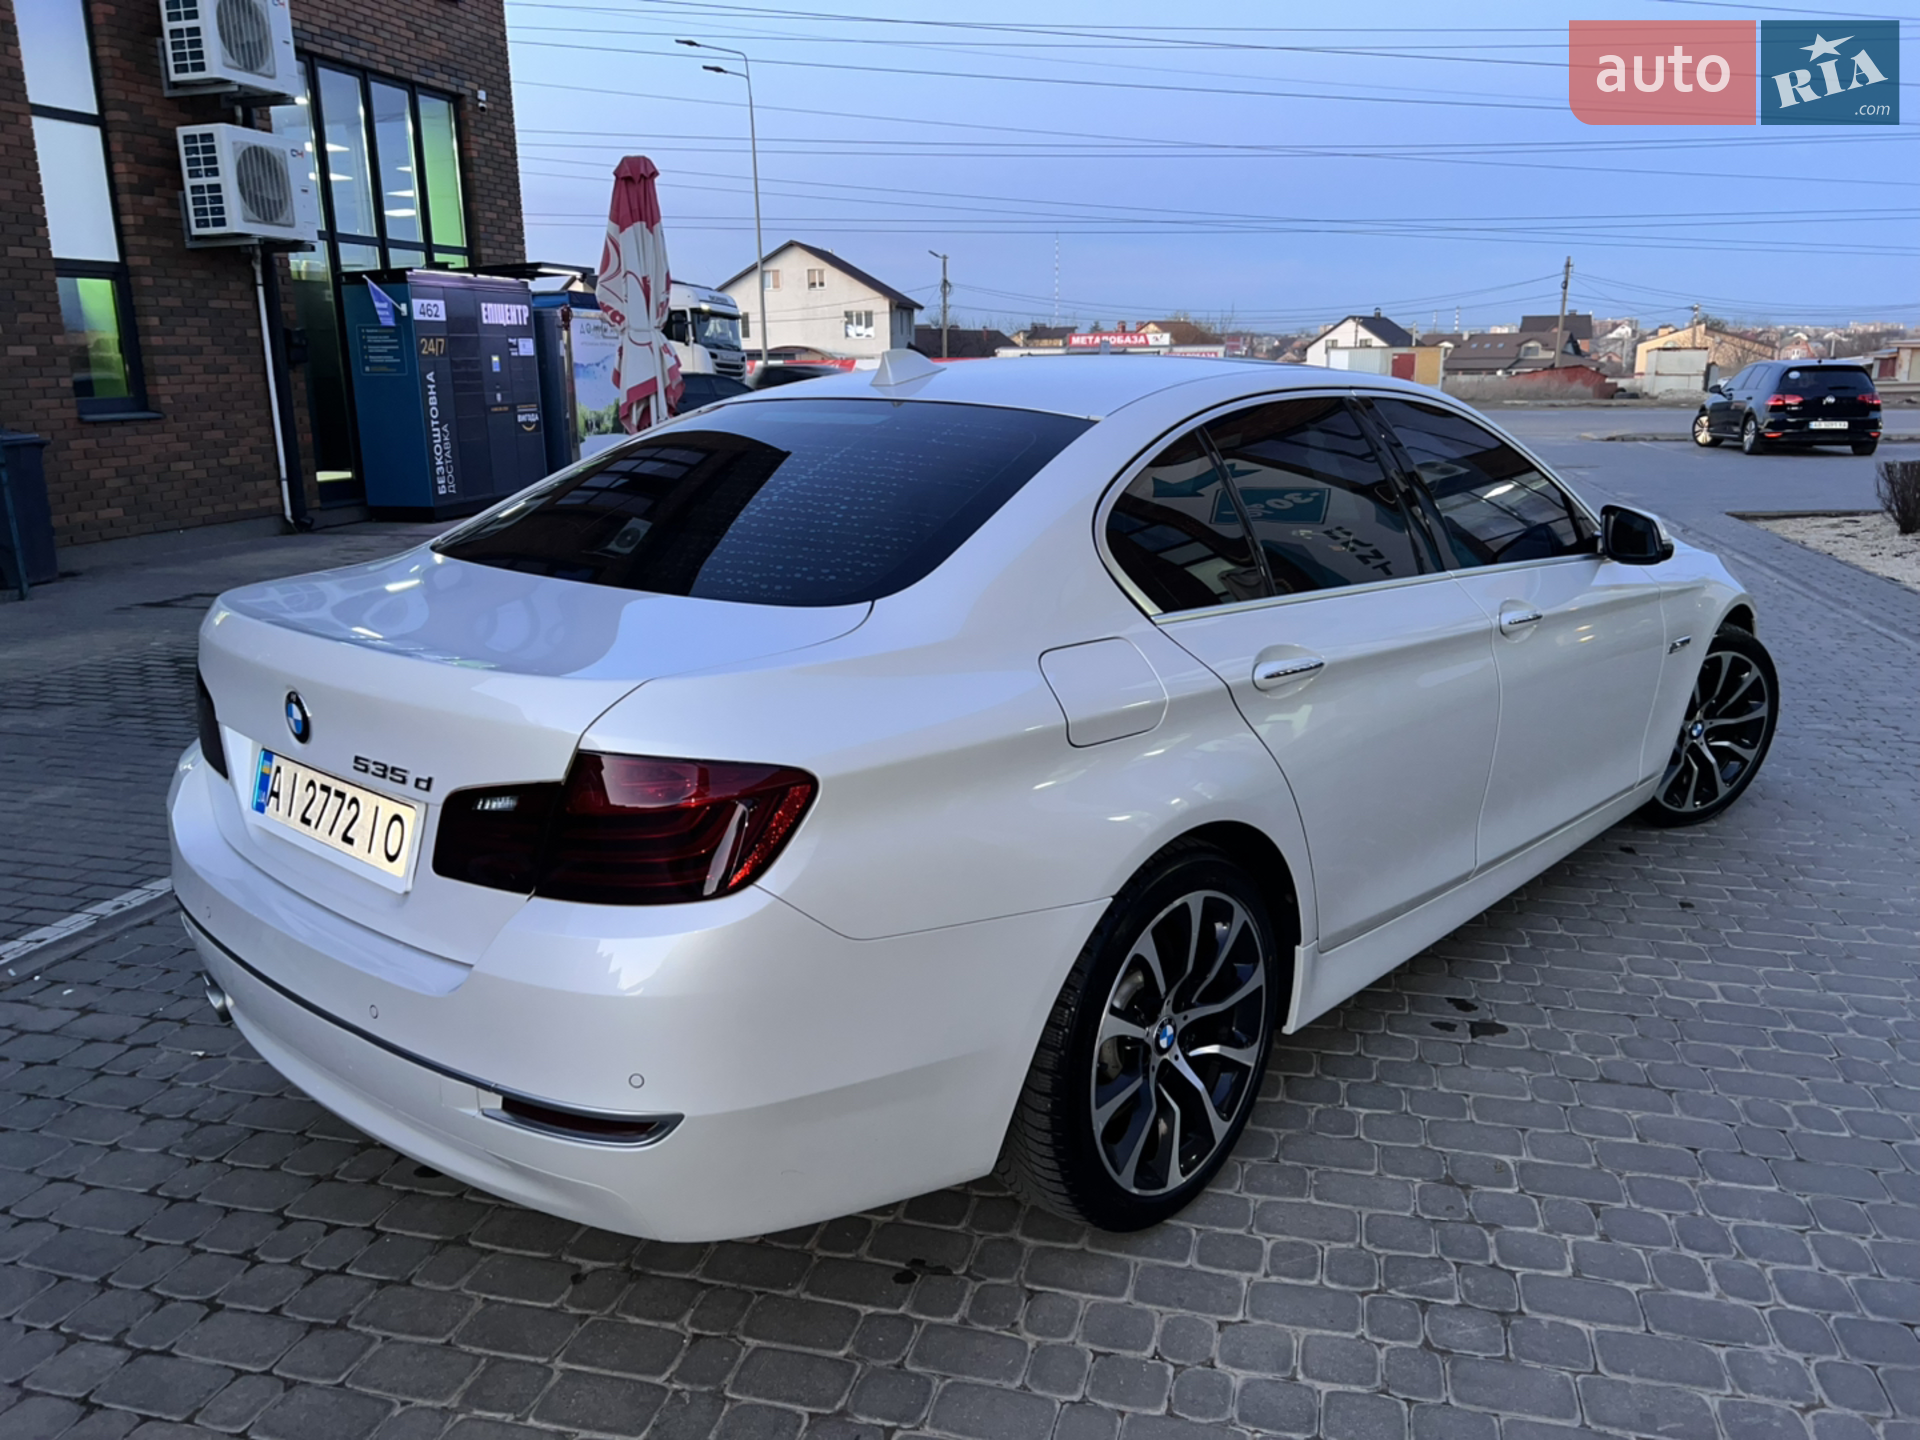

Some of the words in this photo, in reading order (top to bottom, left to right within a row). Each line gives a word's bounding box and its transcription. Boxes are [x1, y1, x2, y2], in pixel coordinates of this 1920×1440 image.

[419, 303, 440, 318] 462
[481, 302, 529, 326] ЕПІЦЕНТР
[426, 371, 447, 495] БЕЗКОШТОВНА
[517, 413, 539, 423] ВИГОДА
[441, 423, 457, 494] ДОСТАВКА
[352, 755, 409, 786] 535
[414, 776, 434, 793] d
[300, 779, 361, 846] 2772
